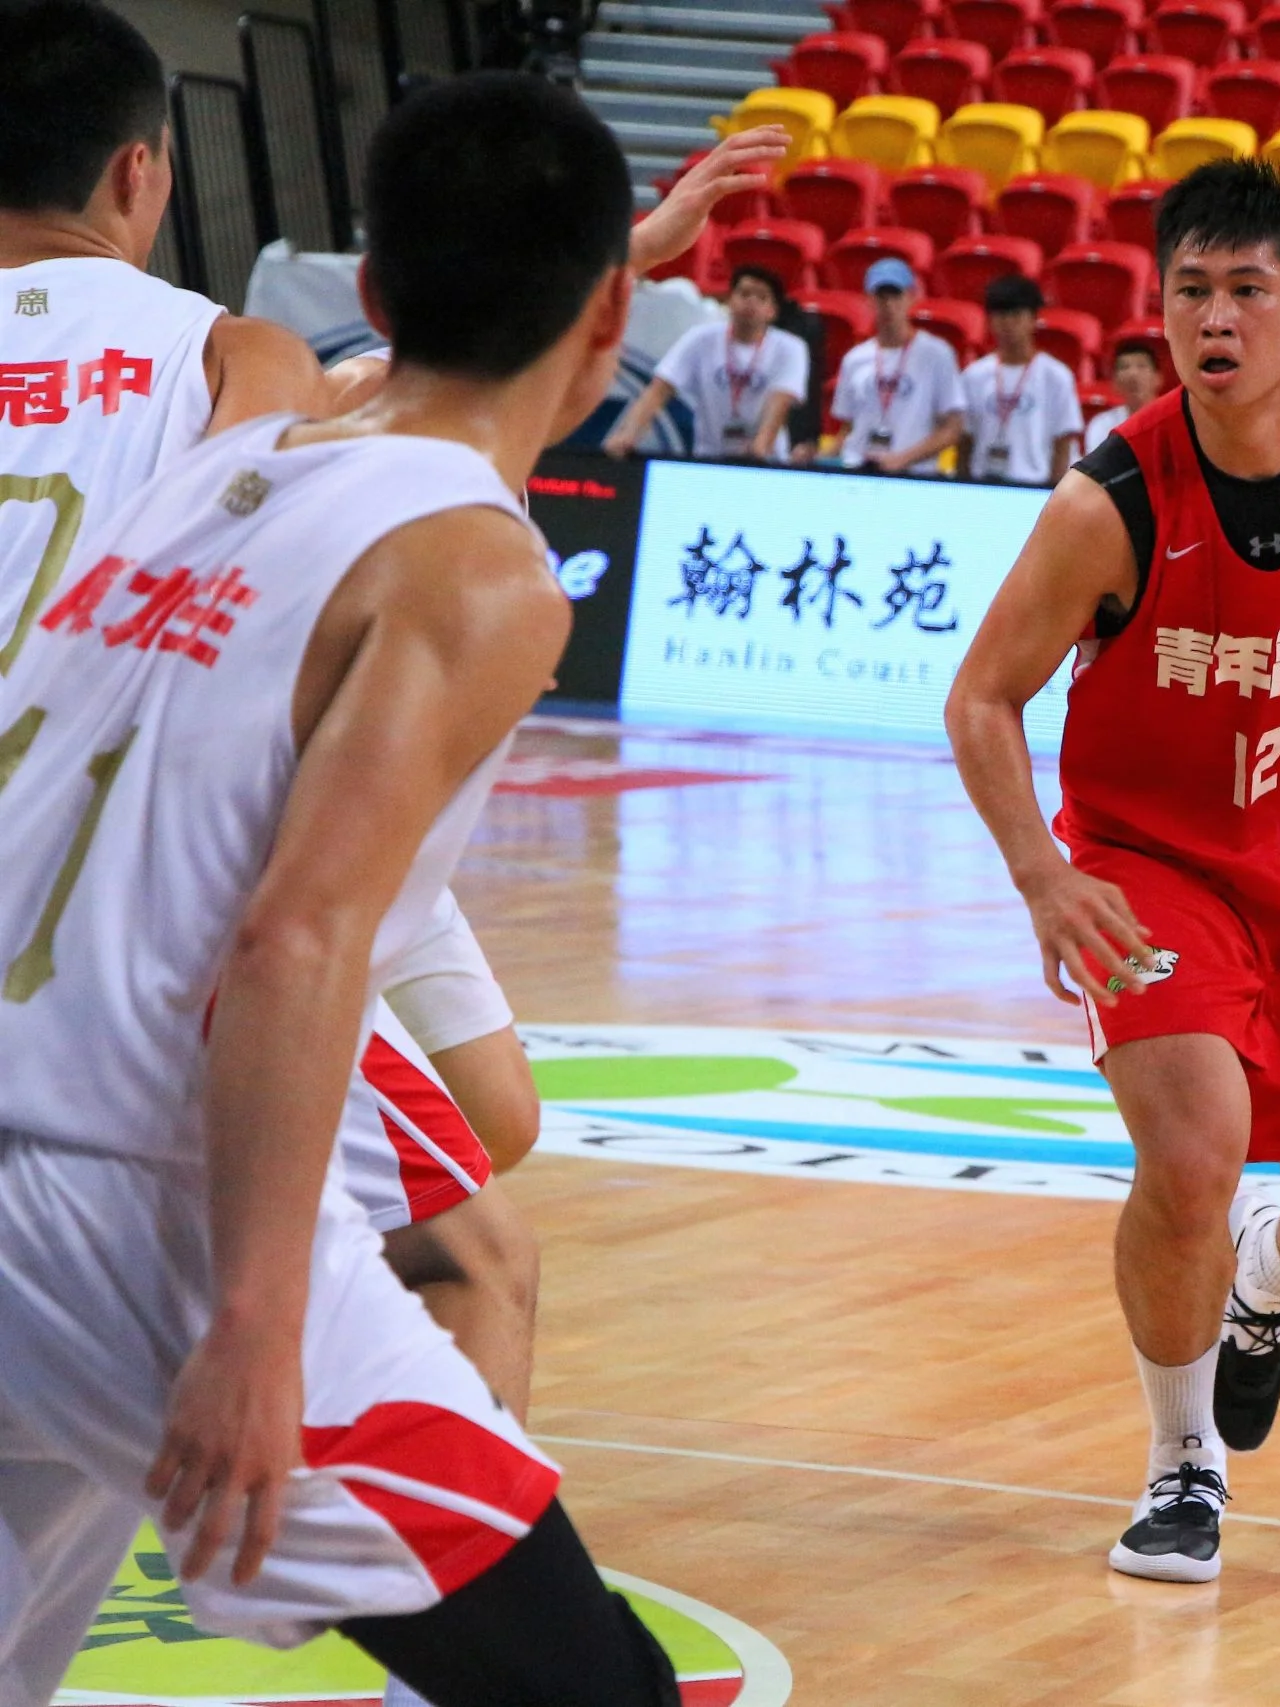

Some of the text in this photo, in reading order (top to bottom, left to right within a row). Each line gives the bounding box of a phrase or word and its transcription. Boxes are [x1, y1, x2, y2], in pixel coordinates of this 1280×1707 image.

[667, 524, 959, 632] 翰林苑
[664, 637, 795, 674] Hanlin
